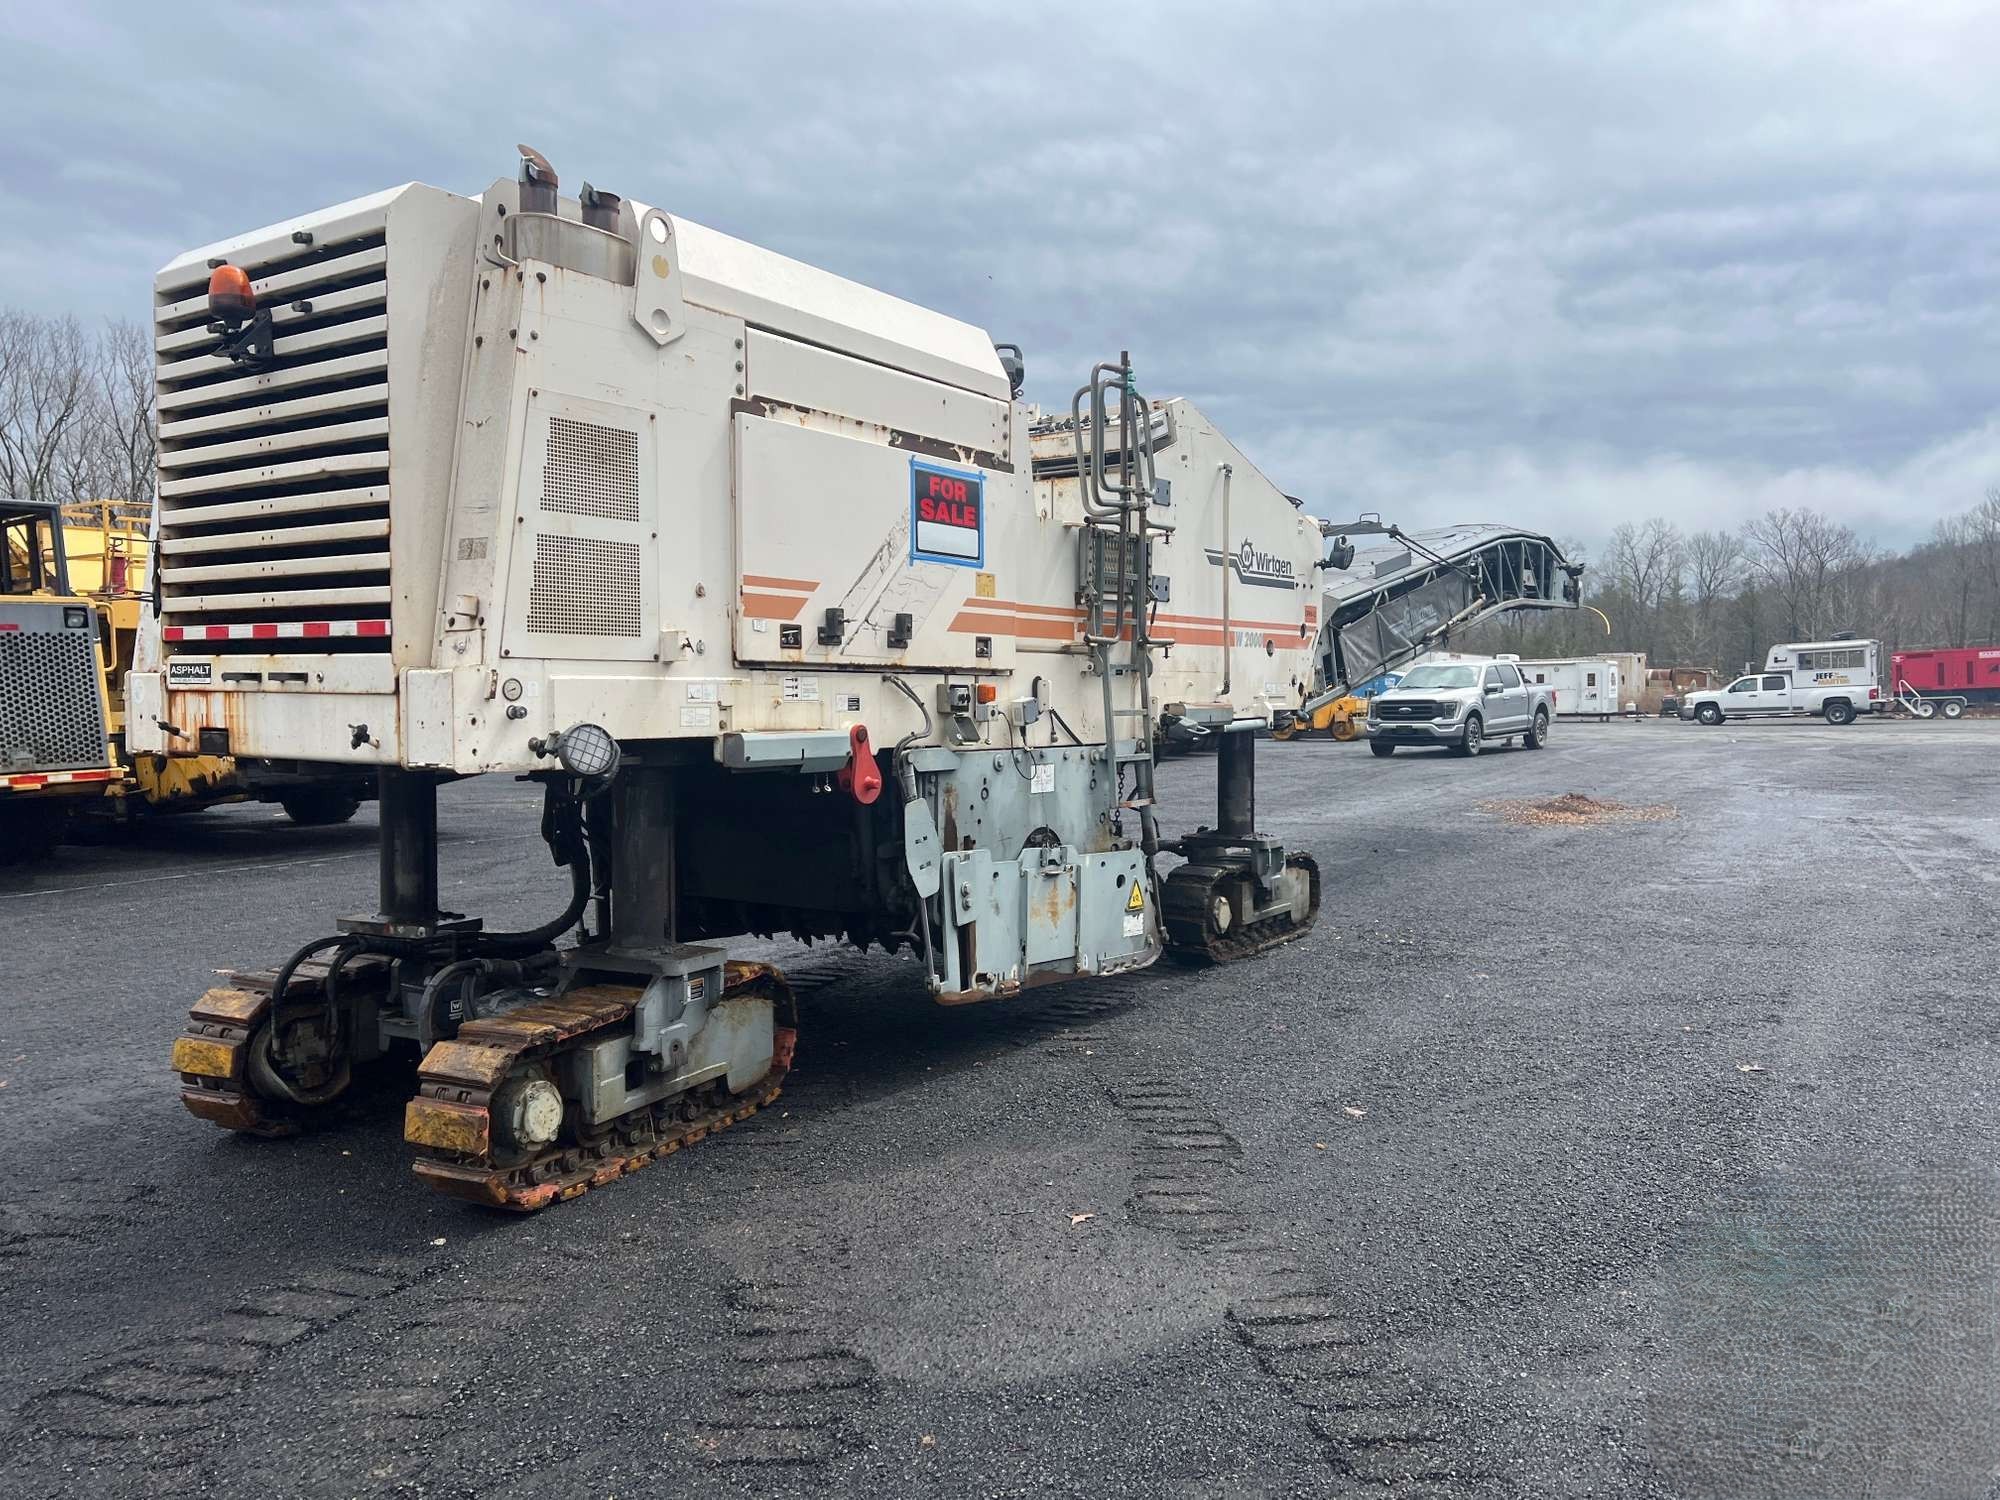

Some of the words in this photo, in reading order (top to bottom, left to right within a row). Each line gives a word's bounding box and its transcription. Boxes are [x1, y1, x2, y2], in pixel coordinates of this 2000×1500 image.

[929, 476, 967, 503] FOR
[920, 498, 976, 528] SALE
[1256, 551, 1292, 577] Wirtgen
[171, 665, 210, 674] ASPHALT
[1814, 672, 1833, 680] JEFF
